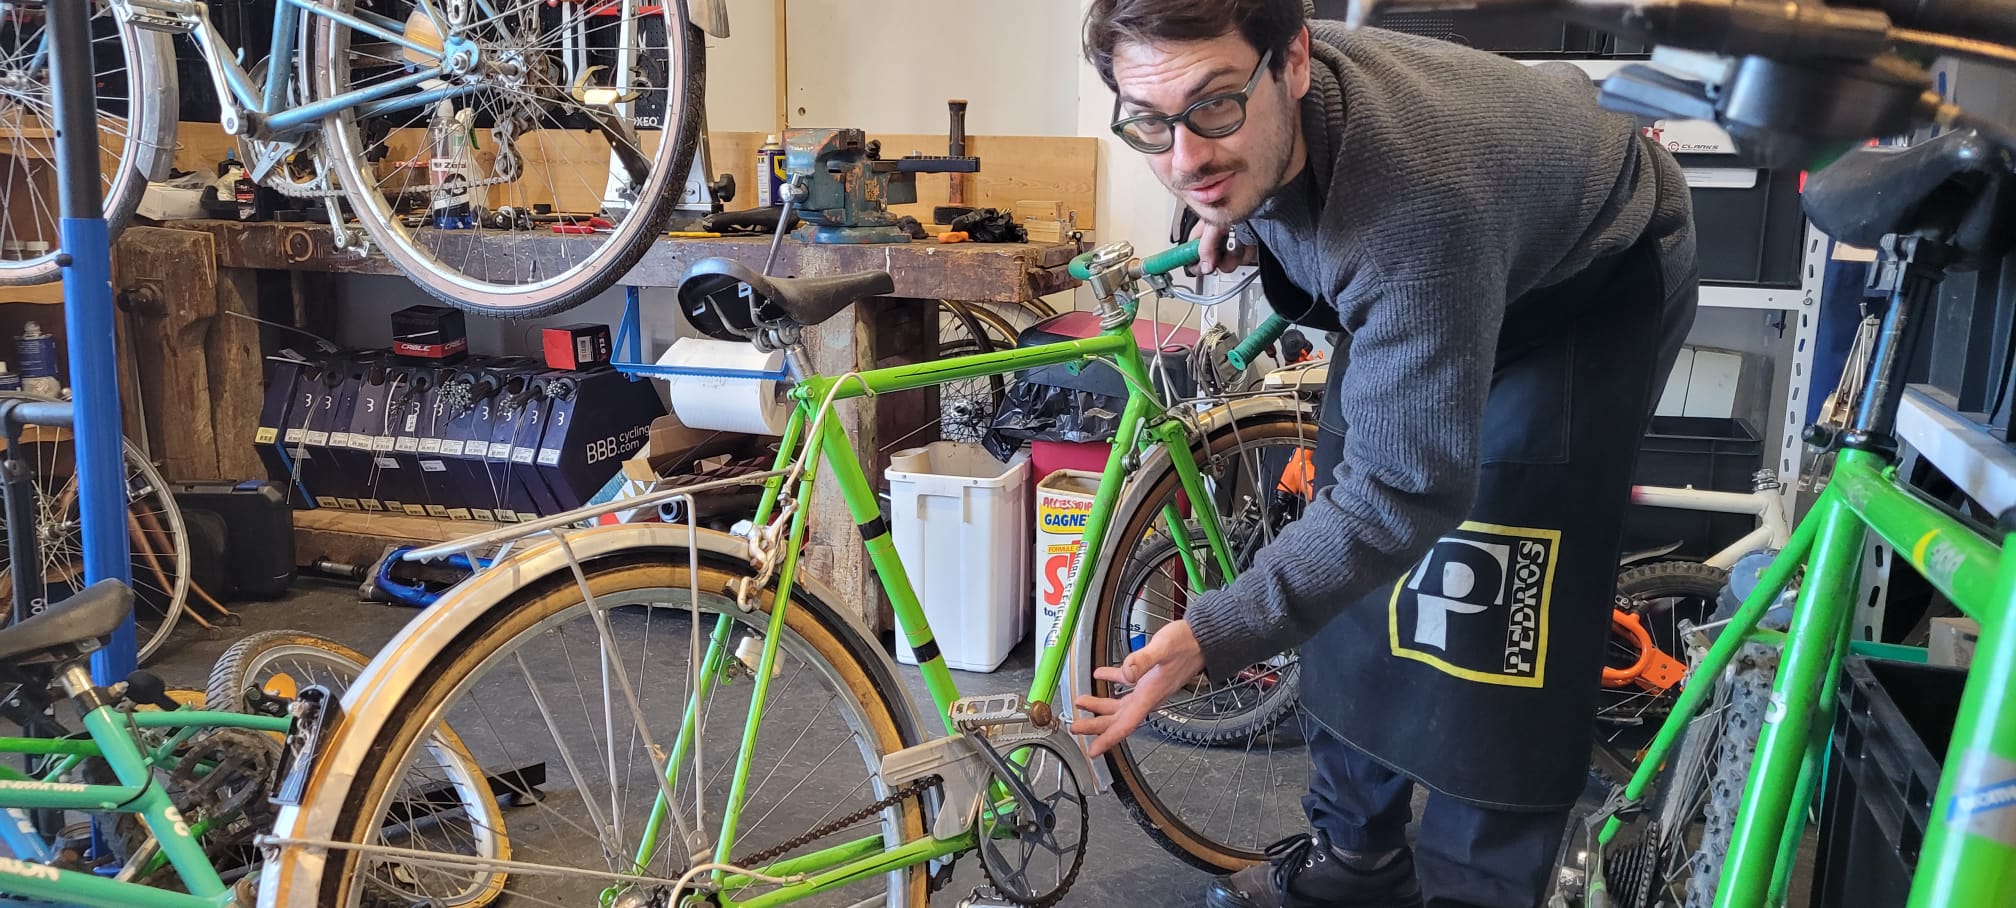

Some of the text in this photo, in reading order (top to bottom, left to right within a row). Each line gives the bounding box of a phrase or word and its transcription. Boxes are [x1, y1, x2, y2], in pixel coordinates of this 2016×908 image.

[400, 343, 432, 352] CABLE
[619, 424, 650, 443] cycling
[1044, 513, 1089, 526] GAGNE
[1503, 540, 1545, 674] PEDROS
